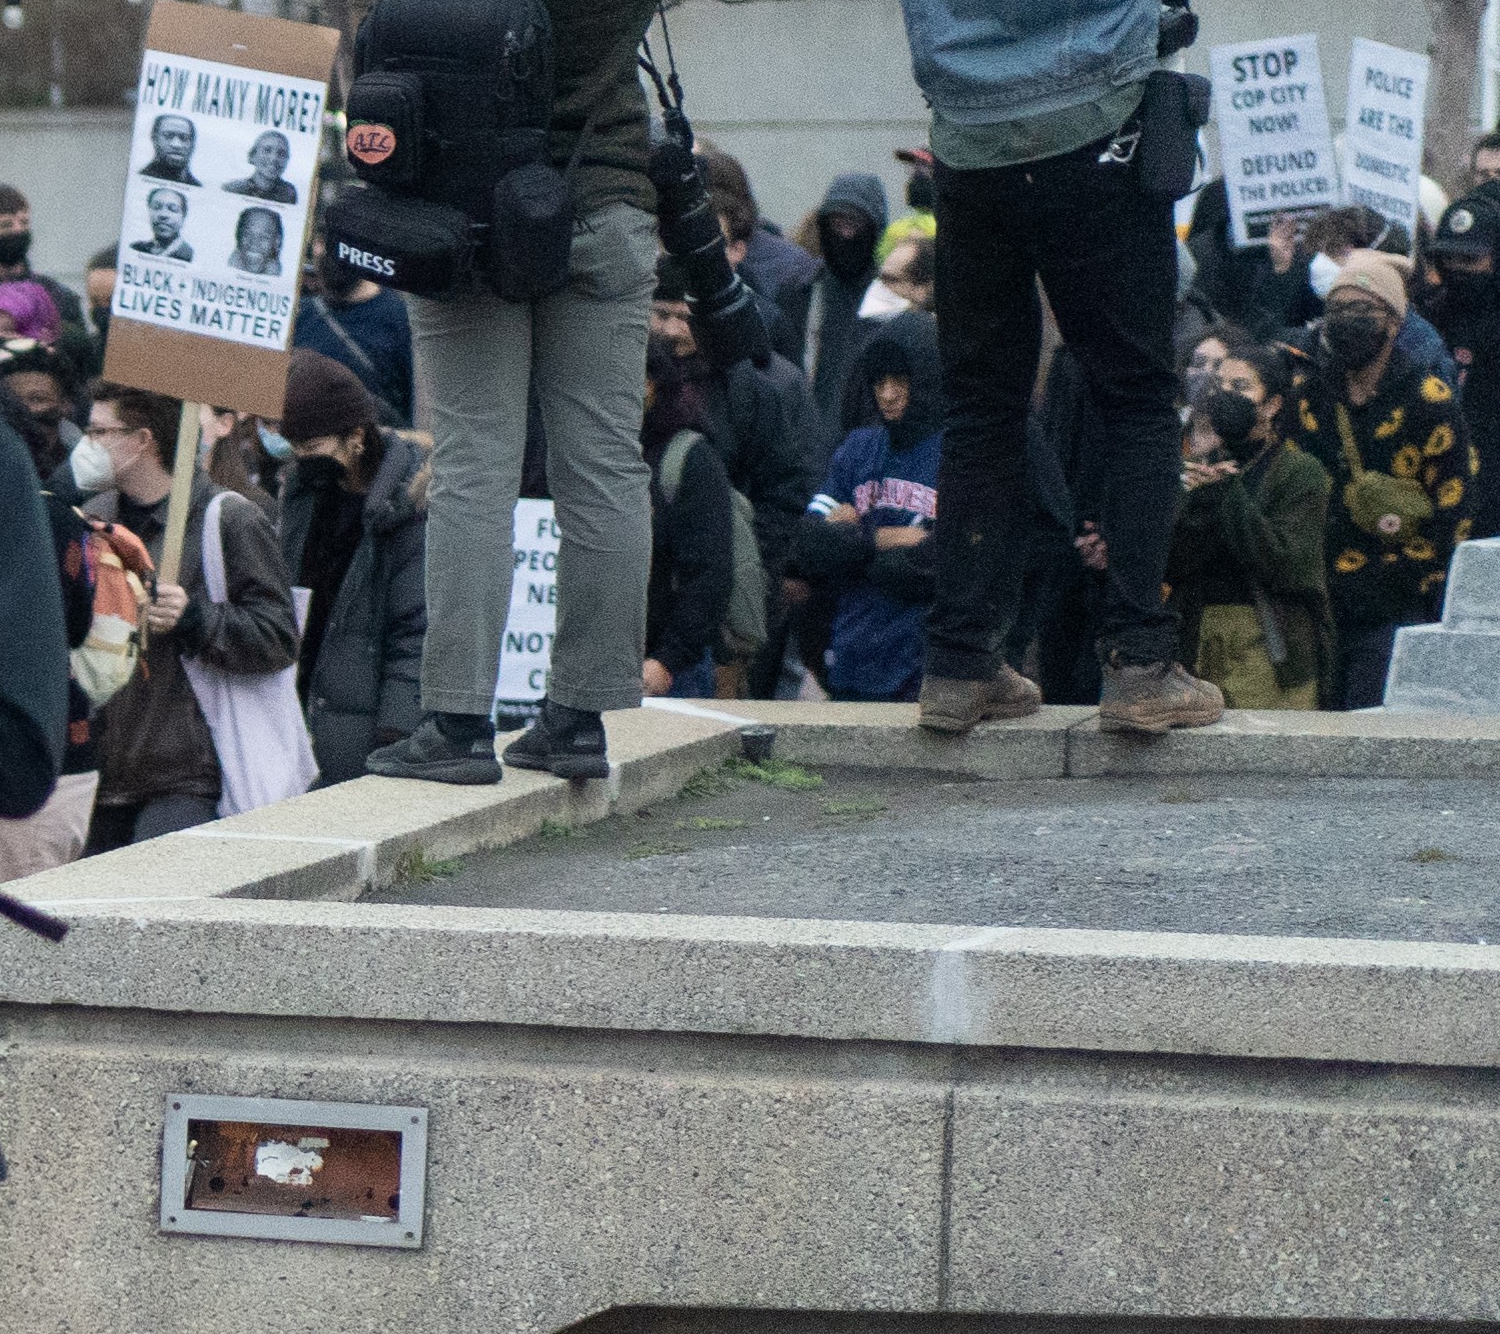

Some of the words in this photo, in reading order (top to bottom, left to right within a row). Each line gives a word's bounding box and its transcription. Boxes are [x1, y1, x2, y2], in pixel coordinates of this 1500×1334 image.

[1232, 48, 1298, 82] STOP
[142, 62, 191, 109] HOW
[192, 71, 252, 122] MANY
[254, 82, 321, 135] MORE?
[1232, 88, 1266, 110] COP
[1270, 82, 1309, 105] CITY
[1365, 66, 1414, 99] POLICE
[1358, 106, 1385, 132] ARE
[1387, 113, 1414, 140] THE
[1242, 149, 1317, 175] DEFUND
[1239, 182, 1267, 201] THE
[337, 241, 396, 277] PRESS
[122, 264, 173, 295] BLACK
[191, 278, 291, 318] INDIGENOUS
[118, 288, 183, 320] LIVES
[189, 302, 283, 341] MATTER
